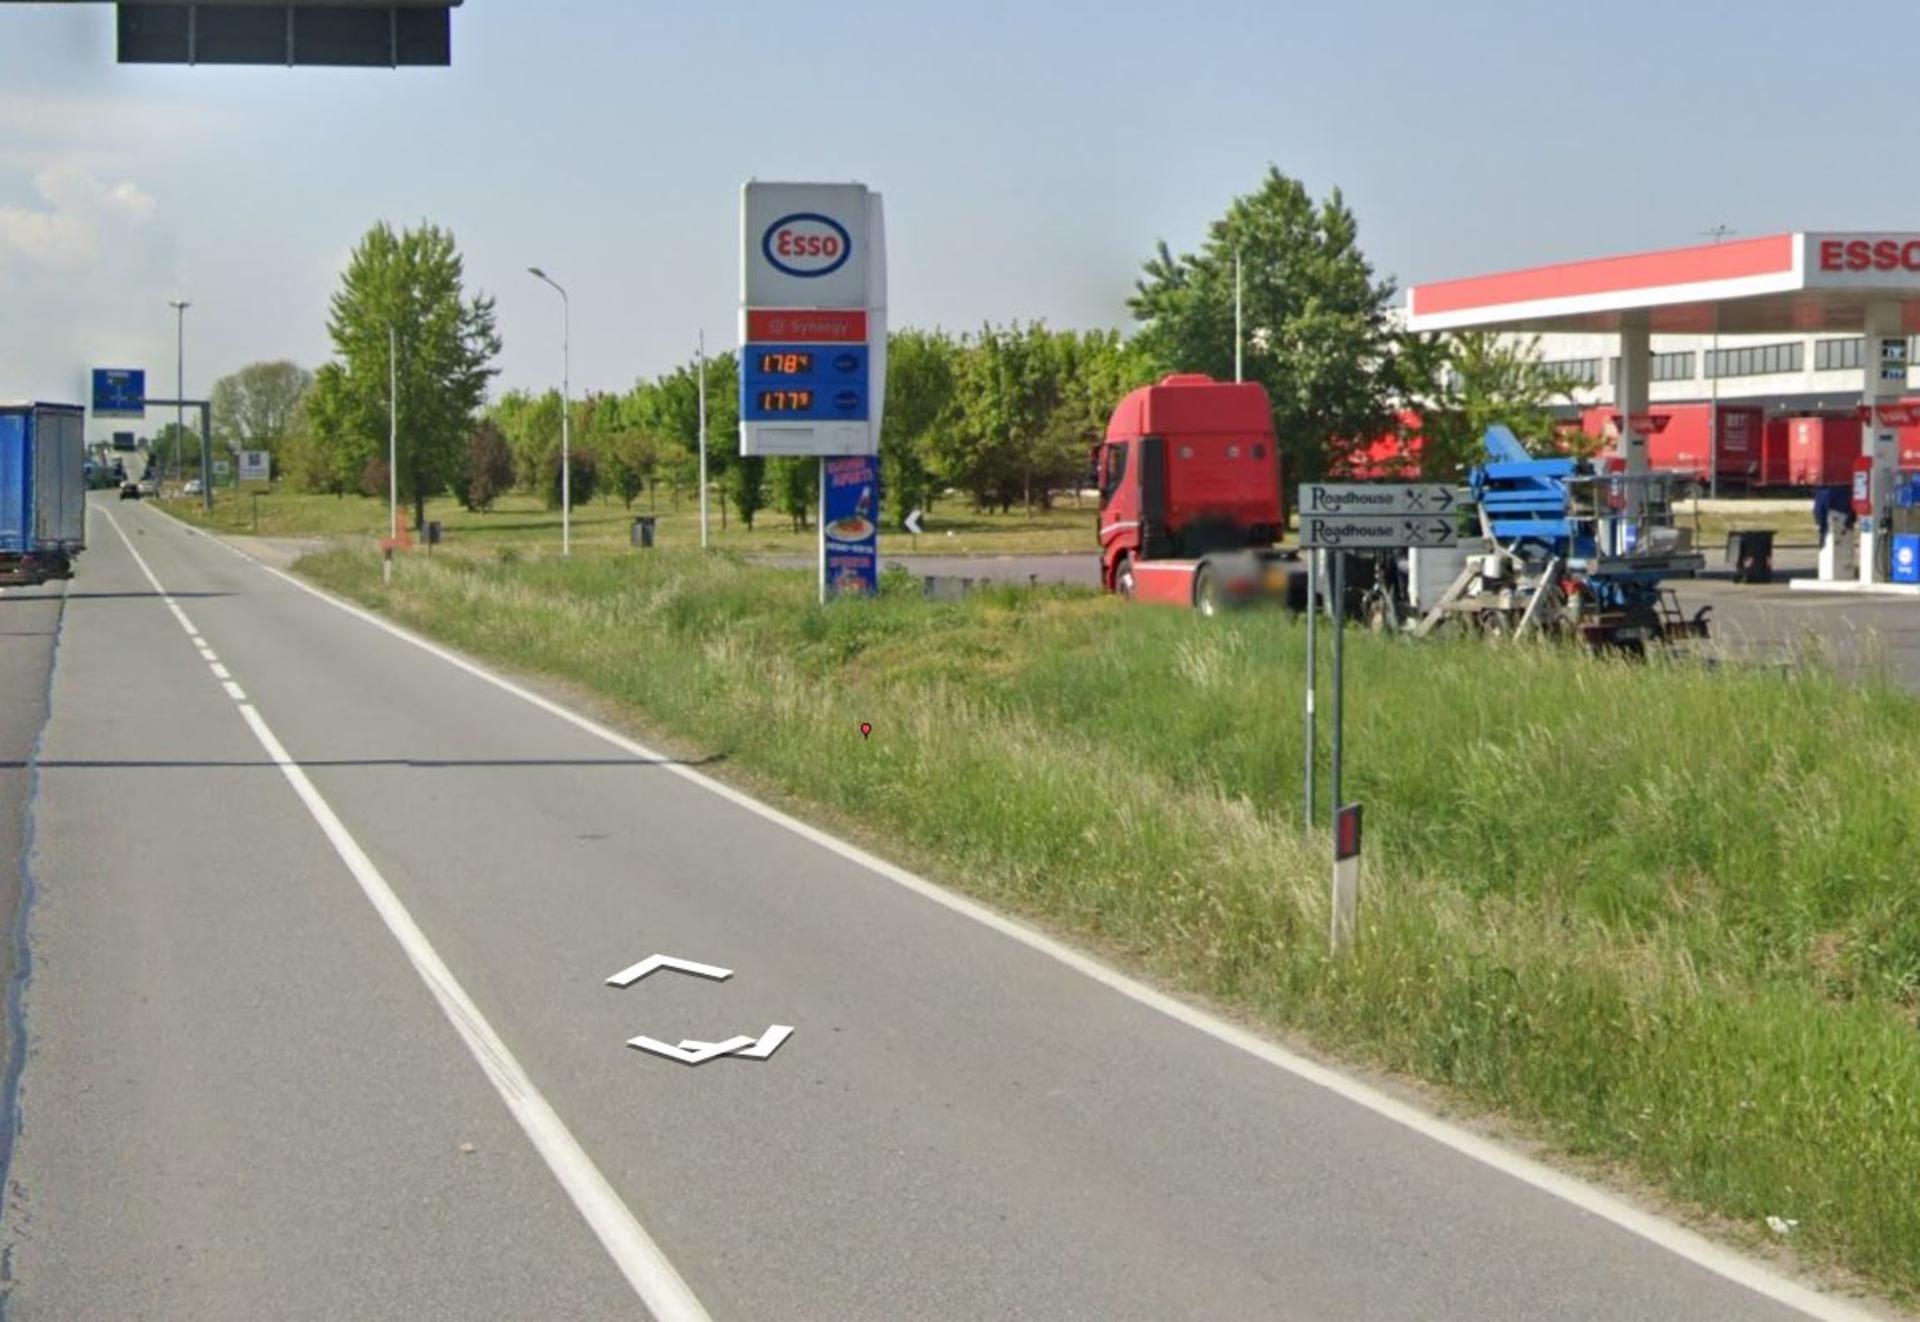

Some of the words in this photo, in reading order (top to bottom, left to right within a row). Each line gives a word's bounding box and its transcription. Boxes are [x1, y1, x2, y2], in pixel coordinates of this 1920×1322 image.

[777, 230, 839, 256] Esso
[1311, 486, 1394, 512] Roadhouse
[1310, 518, 1394, 545] Roadhouse
